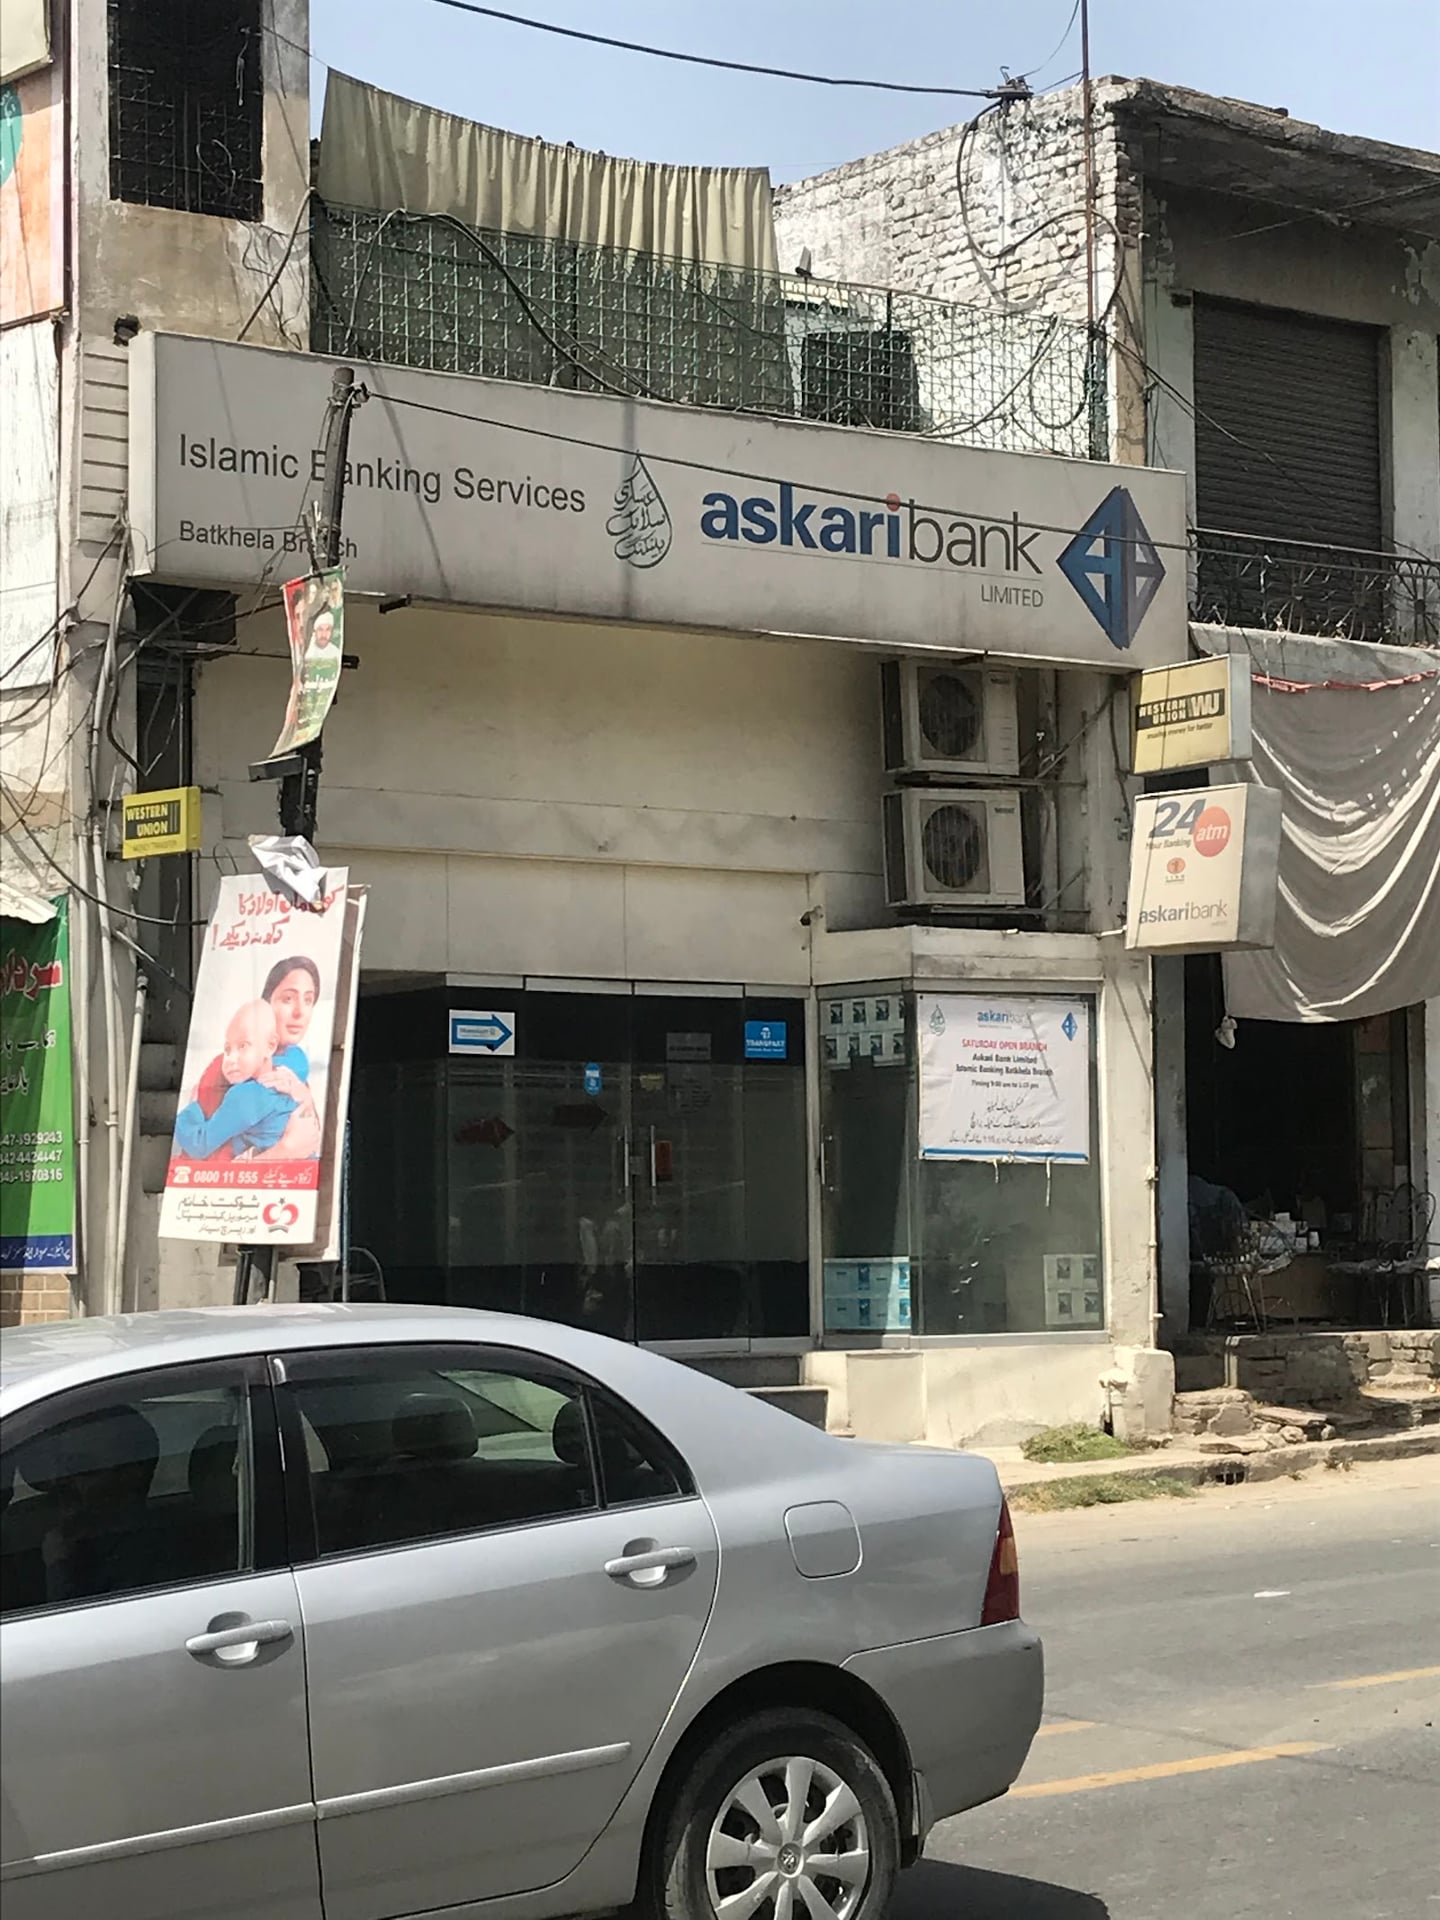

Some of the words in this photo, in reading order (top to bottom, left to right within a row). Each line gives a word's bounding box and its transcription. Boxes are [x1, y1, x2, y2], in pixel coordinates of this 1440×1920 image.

[179, 433, 299, 479] Islamic
[453, 467, 587, 513] Services
[179, 519, 275, 550] Batkhela
[282, 530, 358, 559] Brch
[700, 481, 1044, 575] askaribank
[980, 583, 1044, 609] LIMITED
[1138, 698, 1187, 718] WESTERN
[1190, 692, 1221, 717] WU
[1151, 708, 1187, 725] UNION
[126, 803, 169, 821] WESTERN
[1147, 798, 1207, 838] 24
[136, 820, 169, 837] UNION
[1195, 823, 1229, 842] atm
[1139, 898, 1228, 925] askaribank
[999, 1041, 1018, 1051] OPEN
[193, 1170, 220, 1184] 0800
[222, 1171, 235, 1184] 11
[237, 1171, 259, 1184] 555
